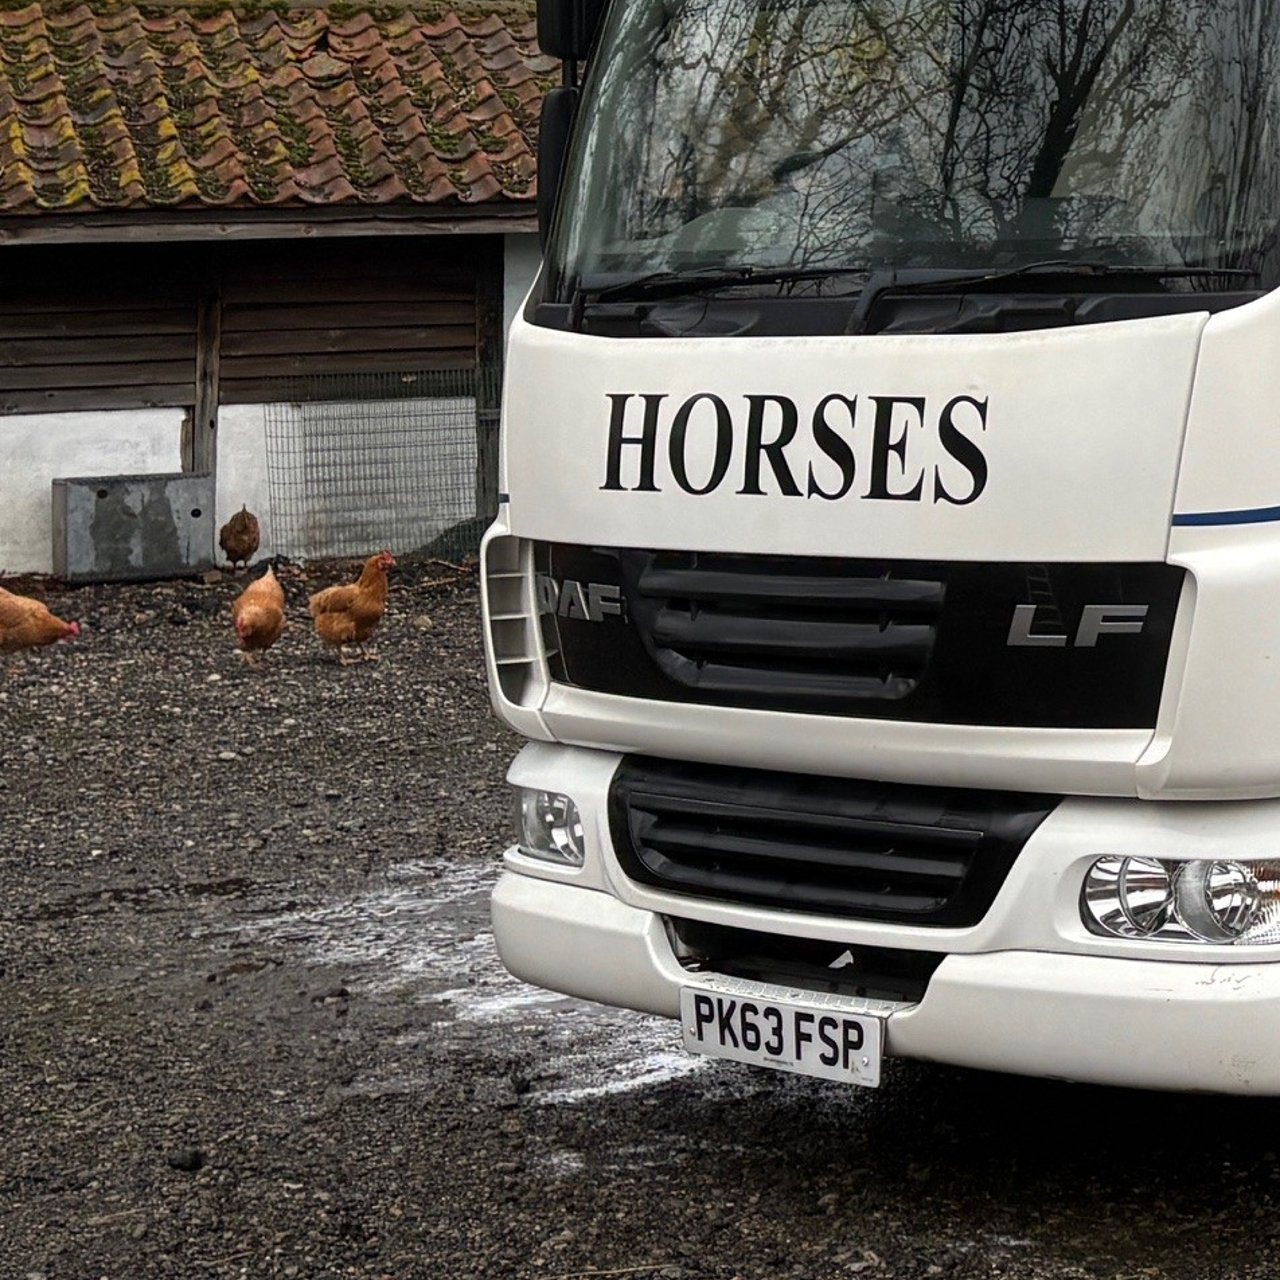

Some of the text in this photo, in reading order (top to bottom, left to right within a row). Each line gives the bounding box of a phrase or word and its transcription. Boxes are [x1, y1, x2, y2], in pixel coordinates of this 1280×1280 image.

[600, 392, 989, 505] HORSES
[1008, 604, 1149, 648] LF
[694, 994, 864, 1069] PK63 FSP
